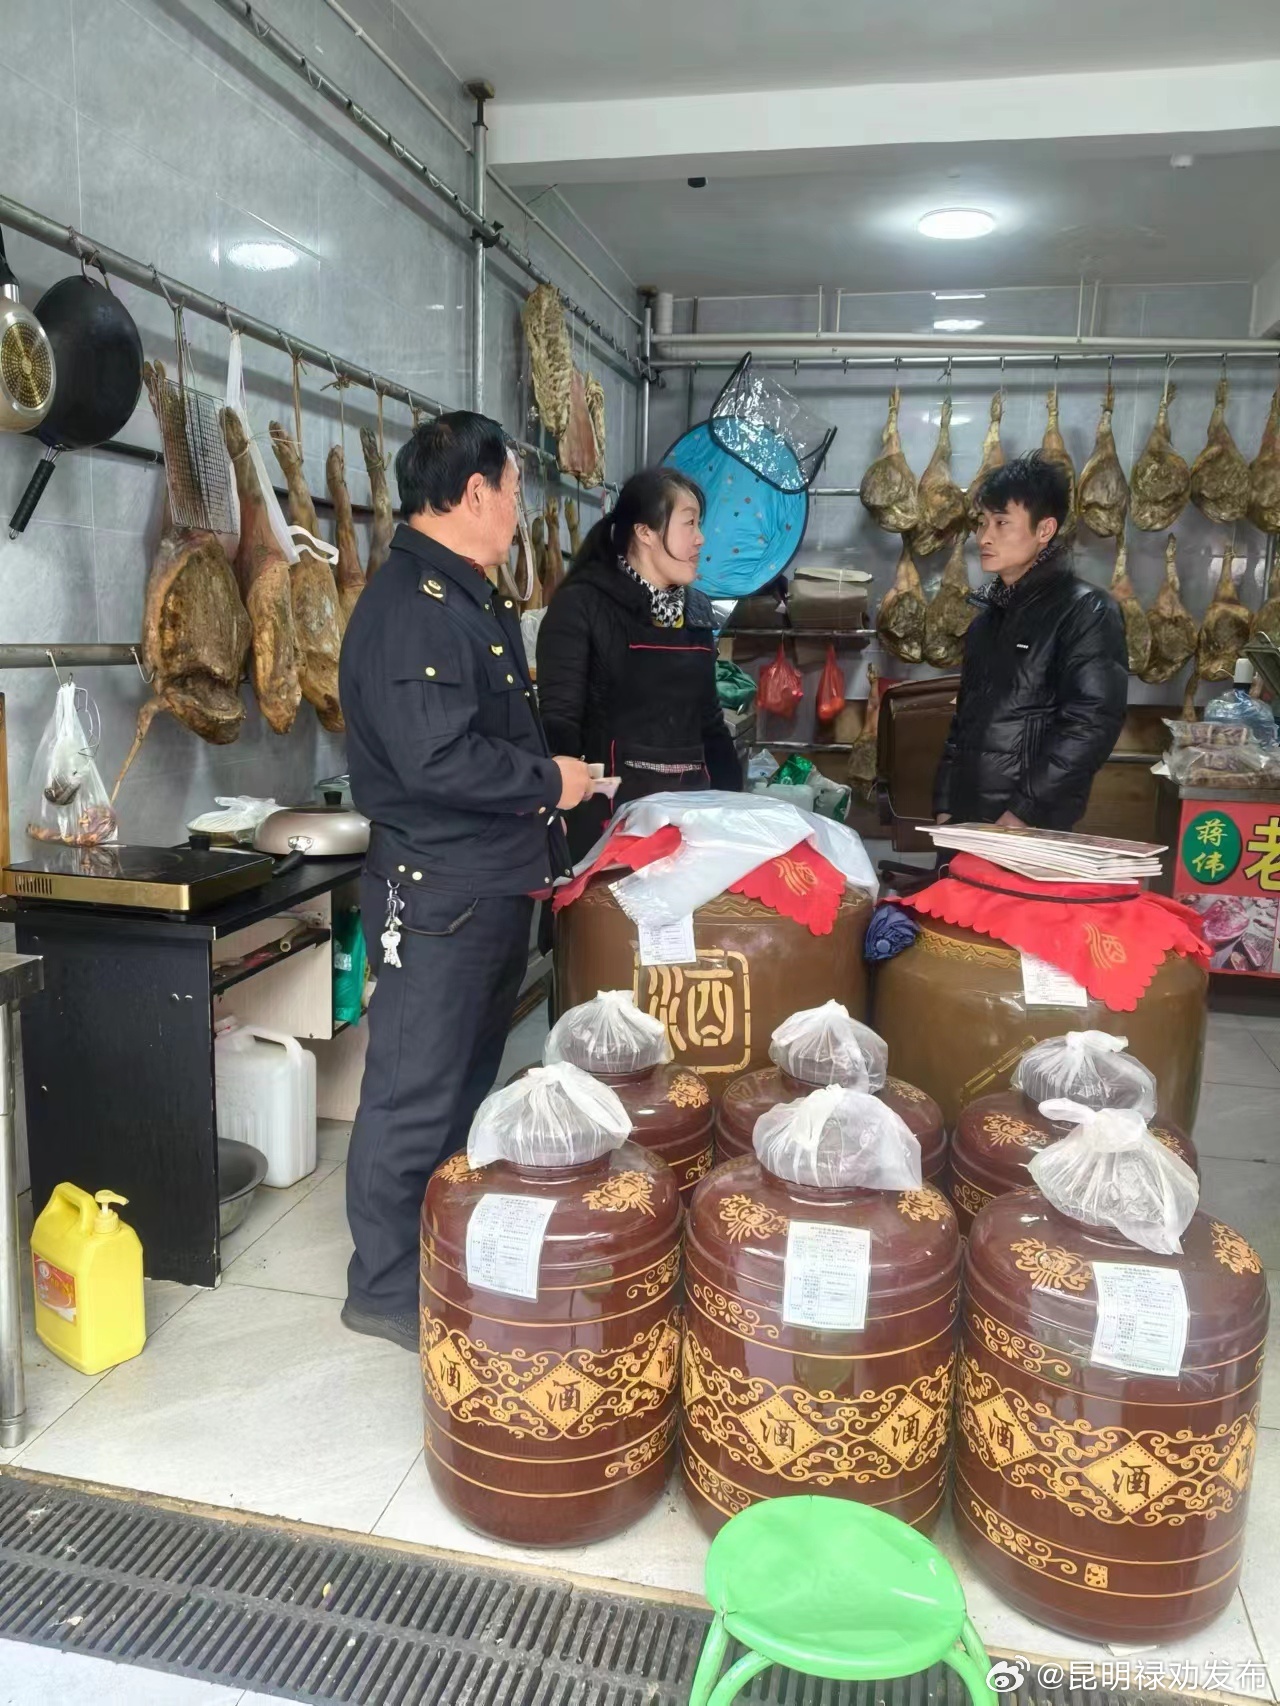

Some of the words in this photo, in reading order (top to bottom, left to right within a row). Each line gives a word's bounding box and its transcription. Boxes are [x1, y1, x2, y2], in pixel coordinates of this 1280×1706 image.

[1192, 818, 1228, 880] 蒋伟
[438, 1353, 462, 1394] 酒
[546, 1379, 583, 1414] 酒
[760, 1409, 797, 1454] 酒
[892, 1407, 922, 1448] 酒
[988, 1411, 1015, 1457] 酒
[1112, 1458, 1151, 1498] 酒
